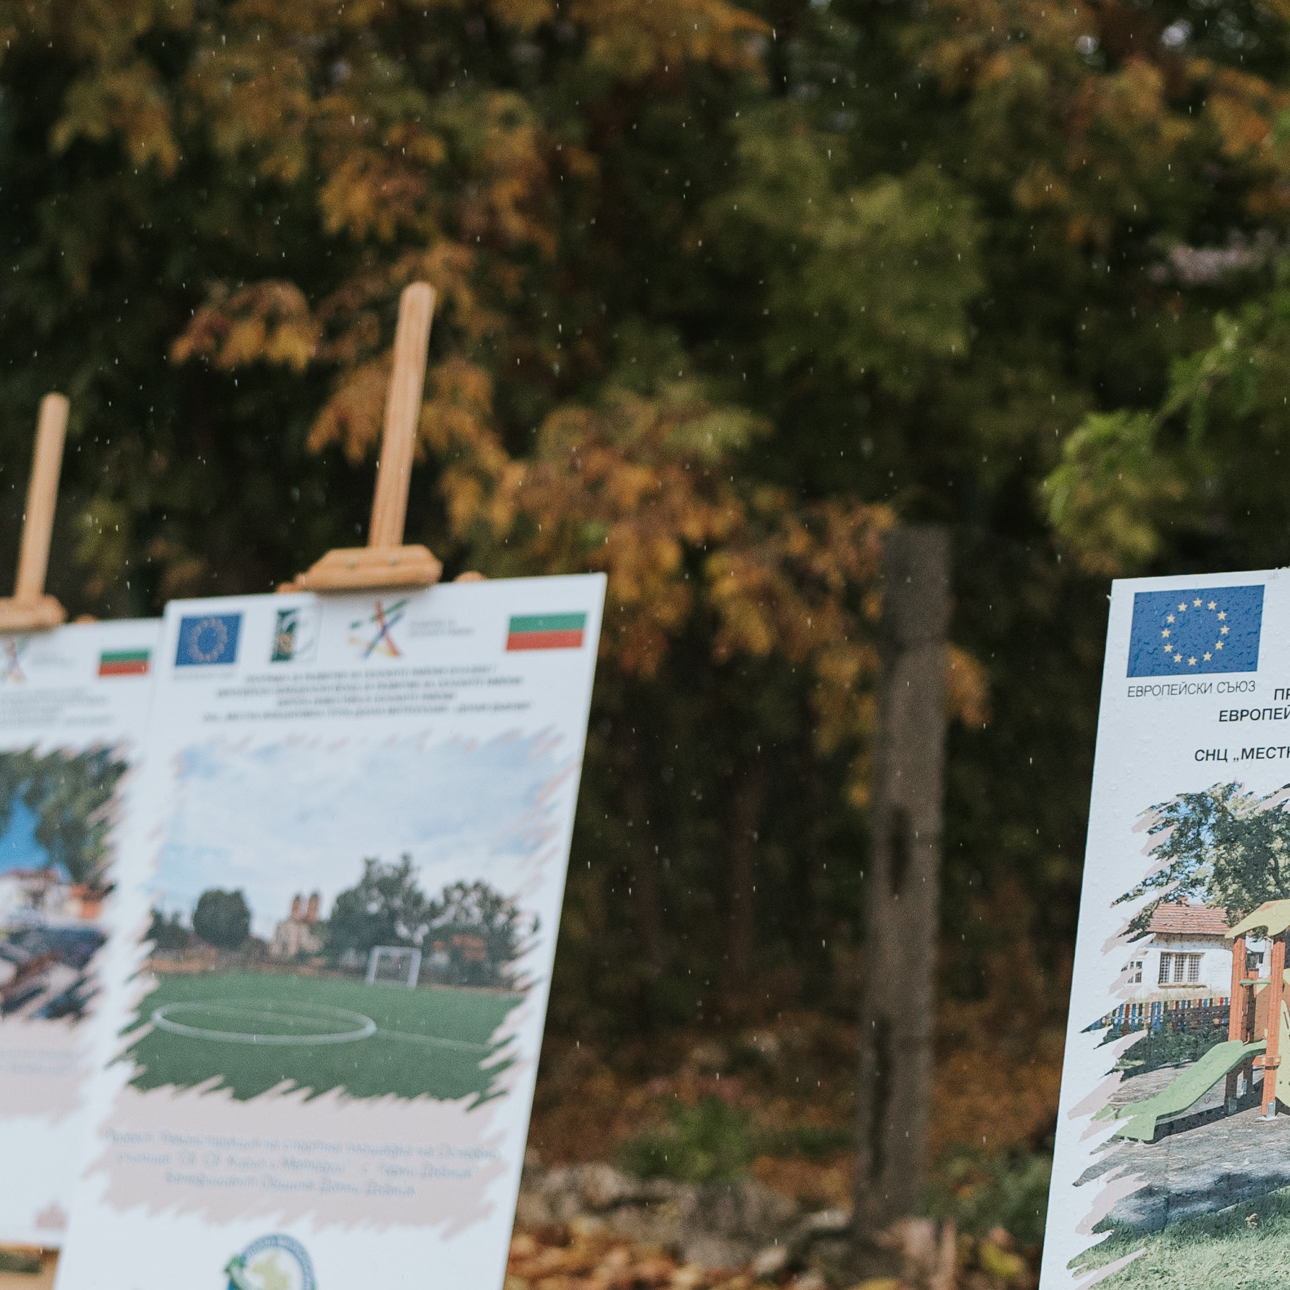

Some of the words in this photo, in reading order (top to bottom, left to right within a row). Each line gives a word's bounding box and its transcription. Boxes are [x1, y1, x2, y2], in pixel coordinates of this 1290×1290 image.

[1127, 682, 1213, 698] ЕВРОПЕЙСКИ
[1217, 680, 1256, 693] СЪЮЗ
[1194, 749, 1228, 763] СНЦ
